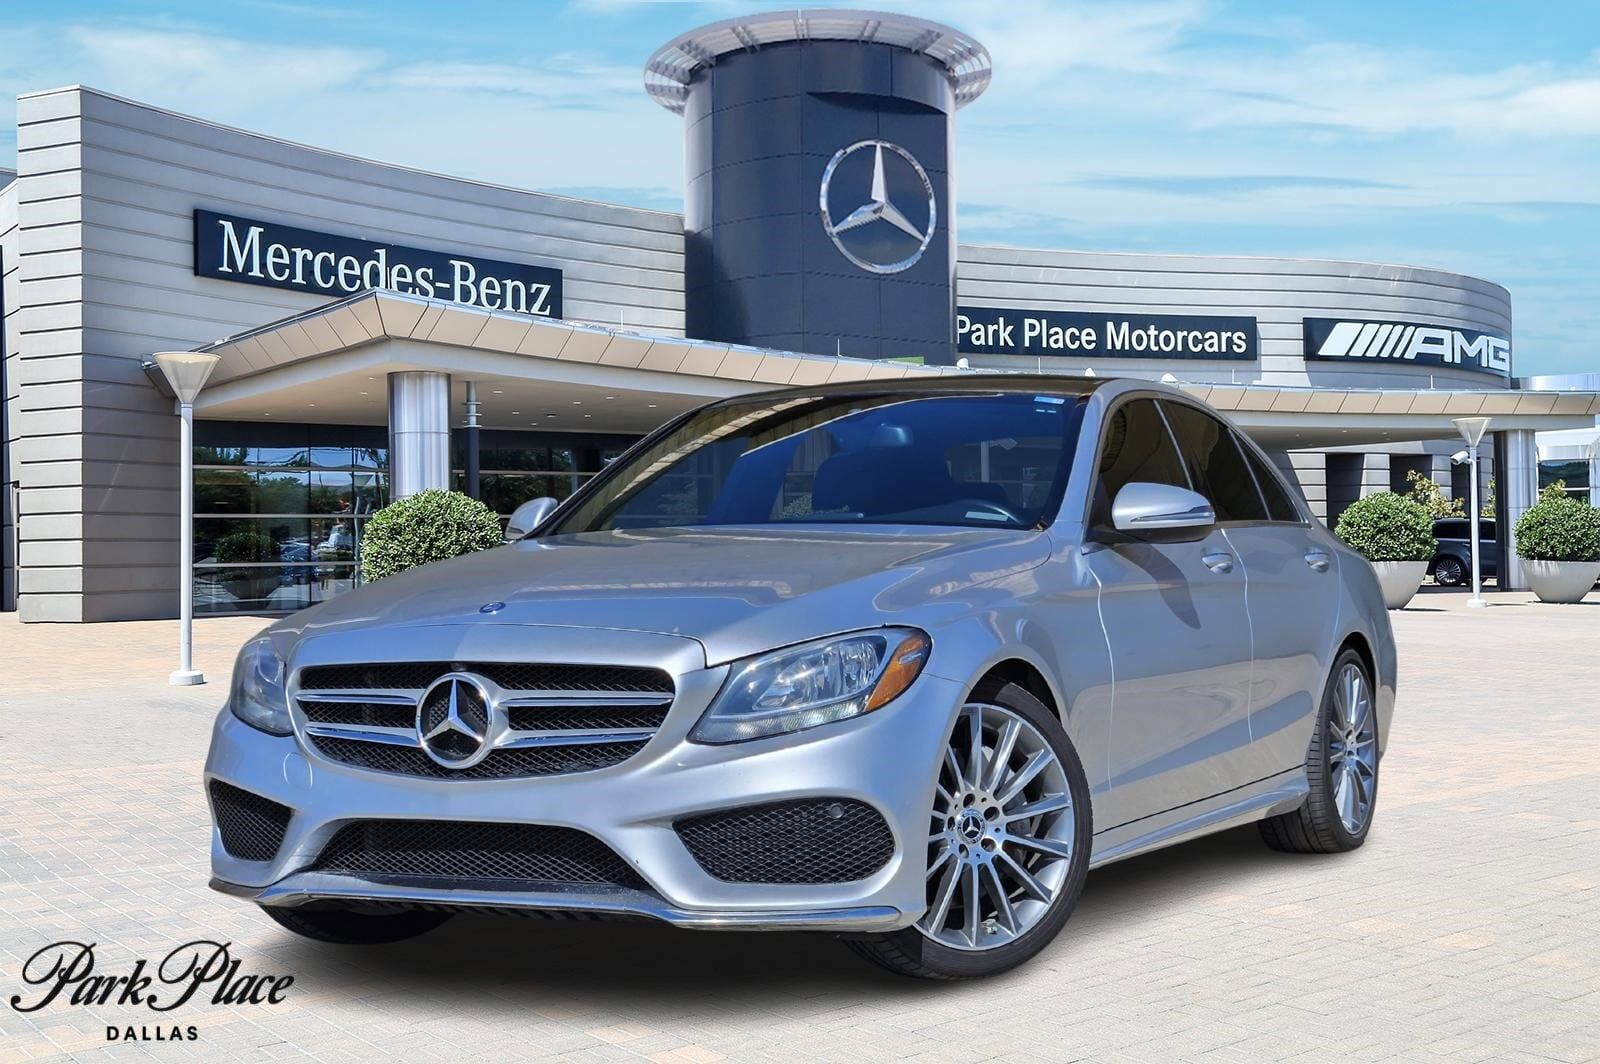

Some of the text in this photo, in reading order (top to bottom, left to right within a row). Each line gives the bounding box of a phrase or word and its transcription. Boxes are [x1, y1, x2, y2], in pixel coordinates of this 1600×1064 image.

[218, 219, 552, 316] Mercedes-Benz
[957, 314, 1247, 353] Park Place Motorcars
[1403, 327, 1510, 372] AMG
